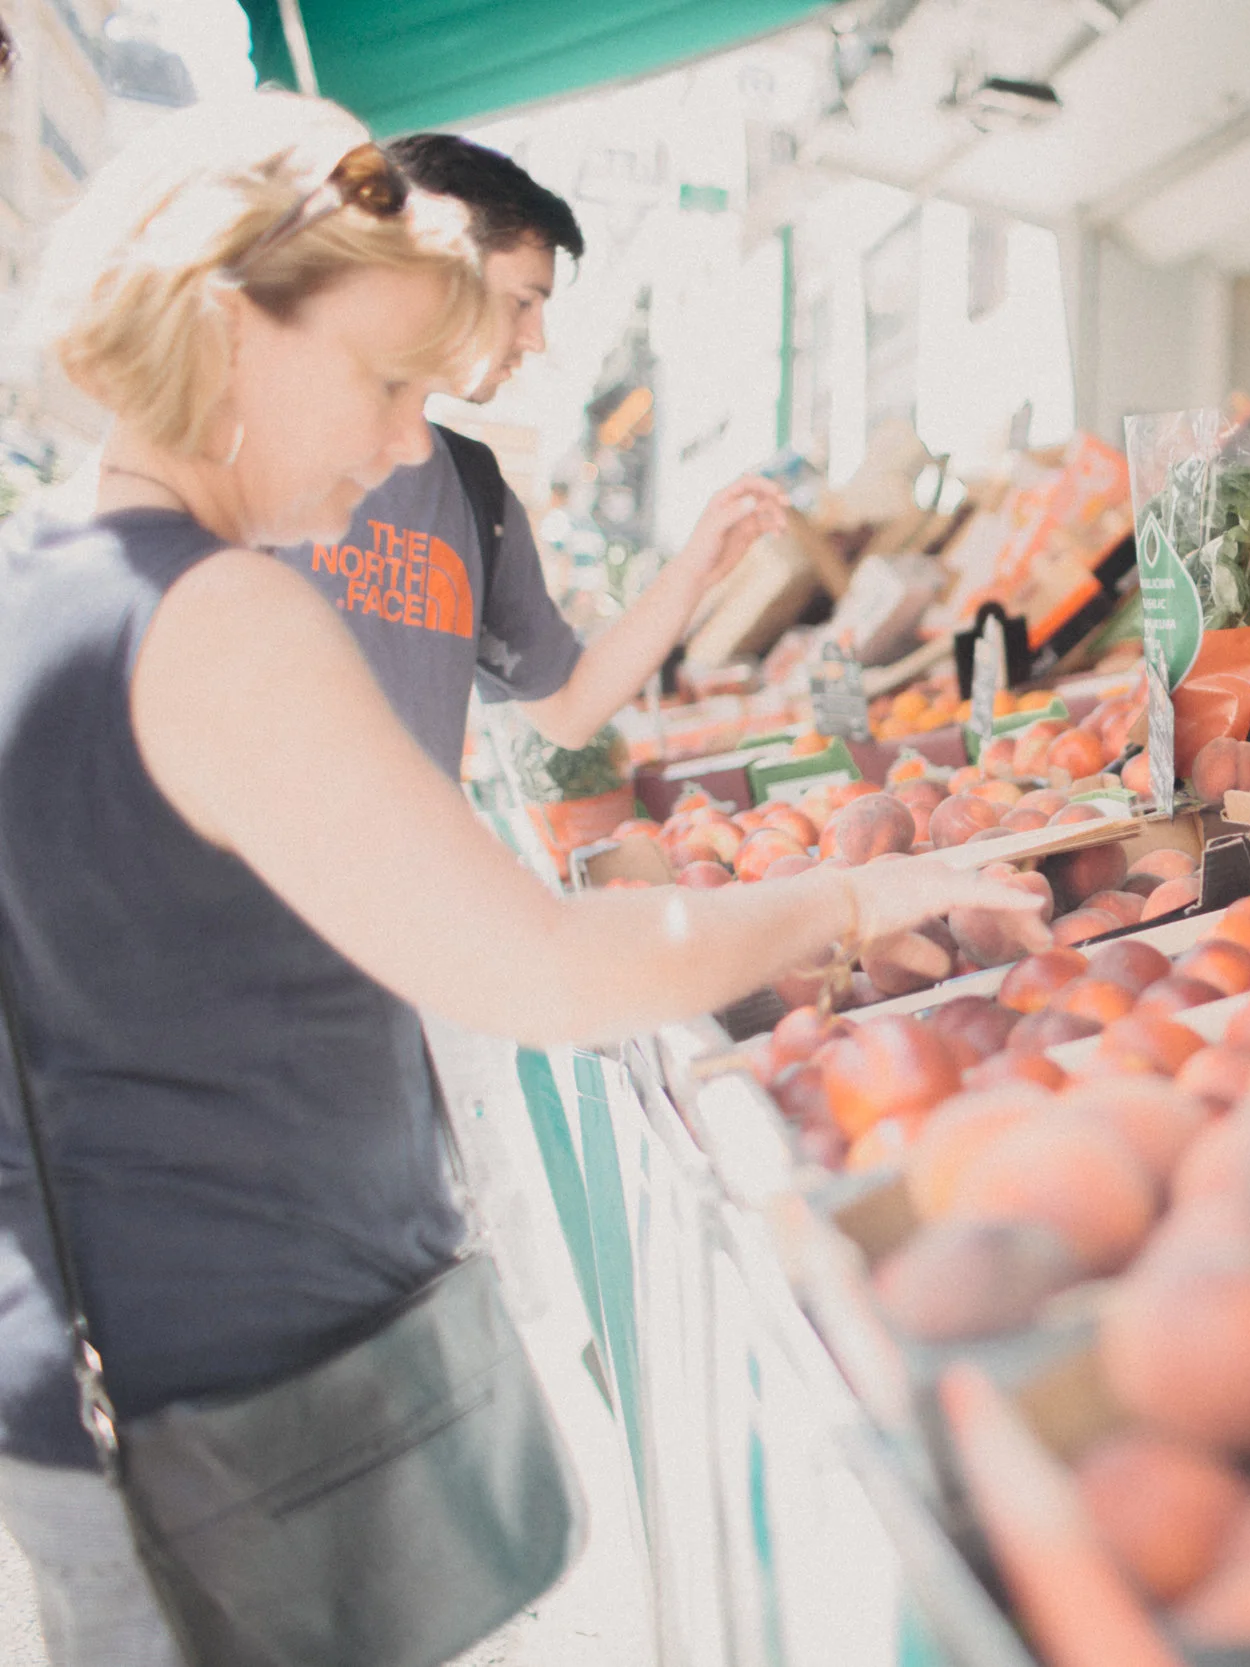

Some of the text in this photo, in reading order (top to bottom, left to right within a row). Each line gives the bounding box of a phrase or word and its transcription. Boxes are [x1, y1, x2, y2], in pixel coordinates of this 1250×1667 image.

[367, 519, 428, 563] THE
[312, 543, 427, 595] NORTH
[347, 579, 424, 627] FACE
